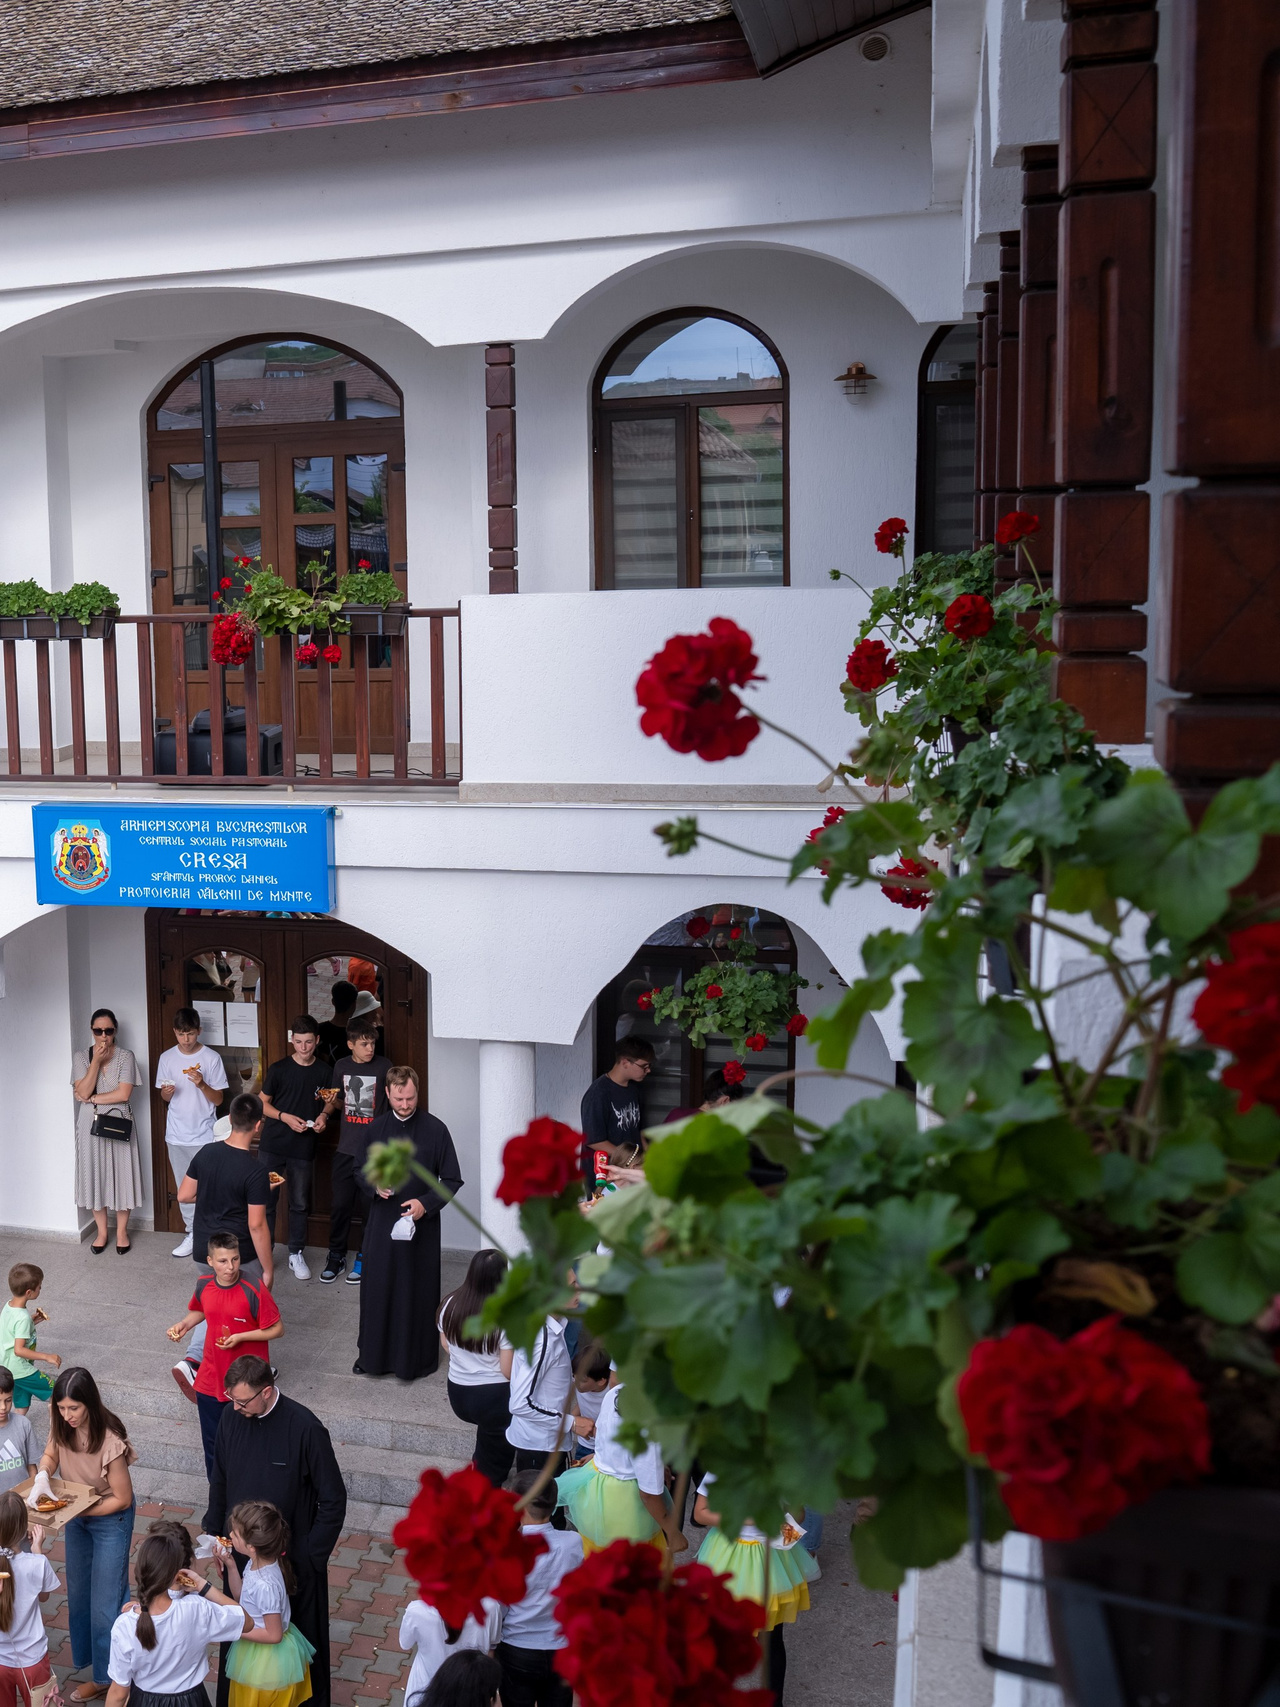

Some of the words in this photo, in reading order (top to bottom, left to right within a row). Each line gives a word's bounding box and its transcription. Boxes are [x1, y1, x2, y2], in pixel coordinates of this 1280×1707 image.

[120, 819, 210, 833] ARHIEPISCOPIA
[138, 836, 185, 847] CENTRUL
[189, 836, 227, 848] SOCIAL
[231, 837, 288, 848] PASTORAL
[151, 870, 195, 882] SFÂNTUL
[198, 873, 237, 883] PROROC
[241, 874, 279, 885] DANIEL
[119, 886, 191, 899] PROTOIERIA
[196, 886, 242, 901] VĂLENII
[247, 889, 264, 901] DE
[269, 890, 313, 902] MUNTE
[346, 1116, 374, 1124] START
